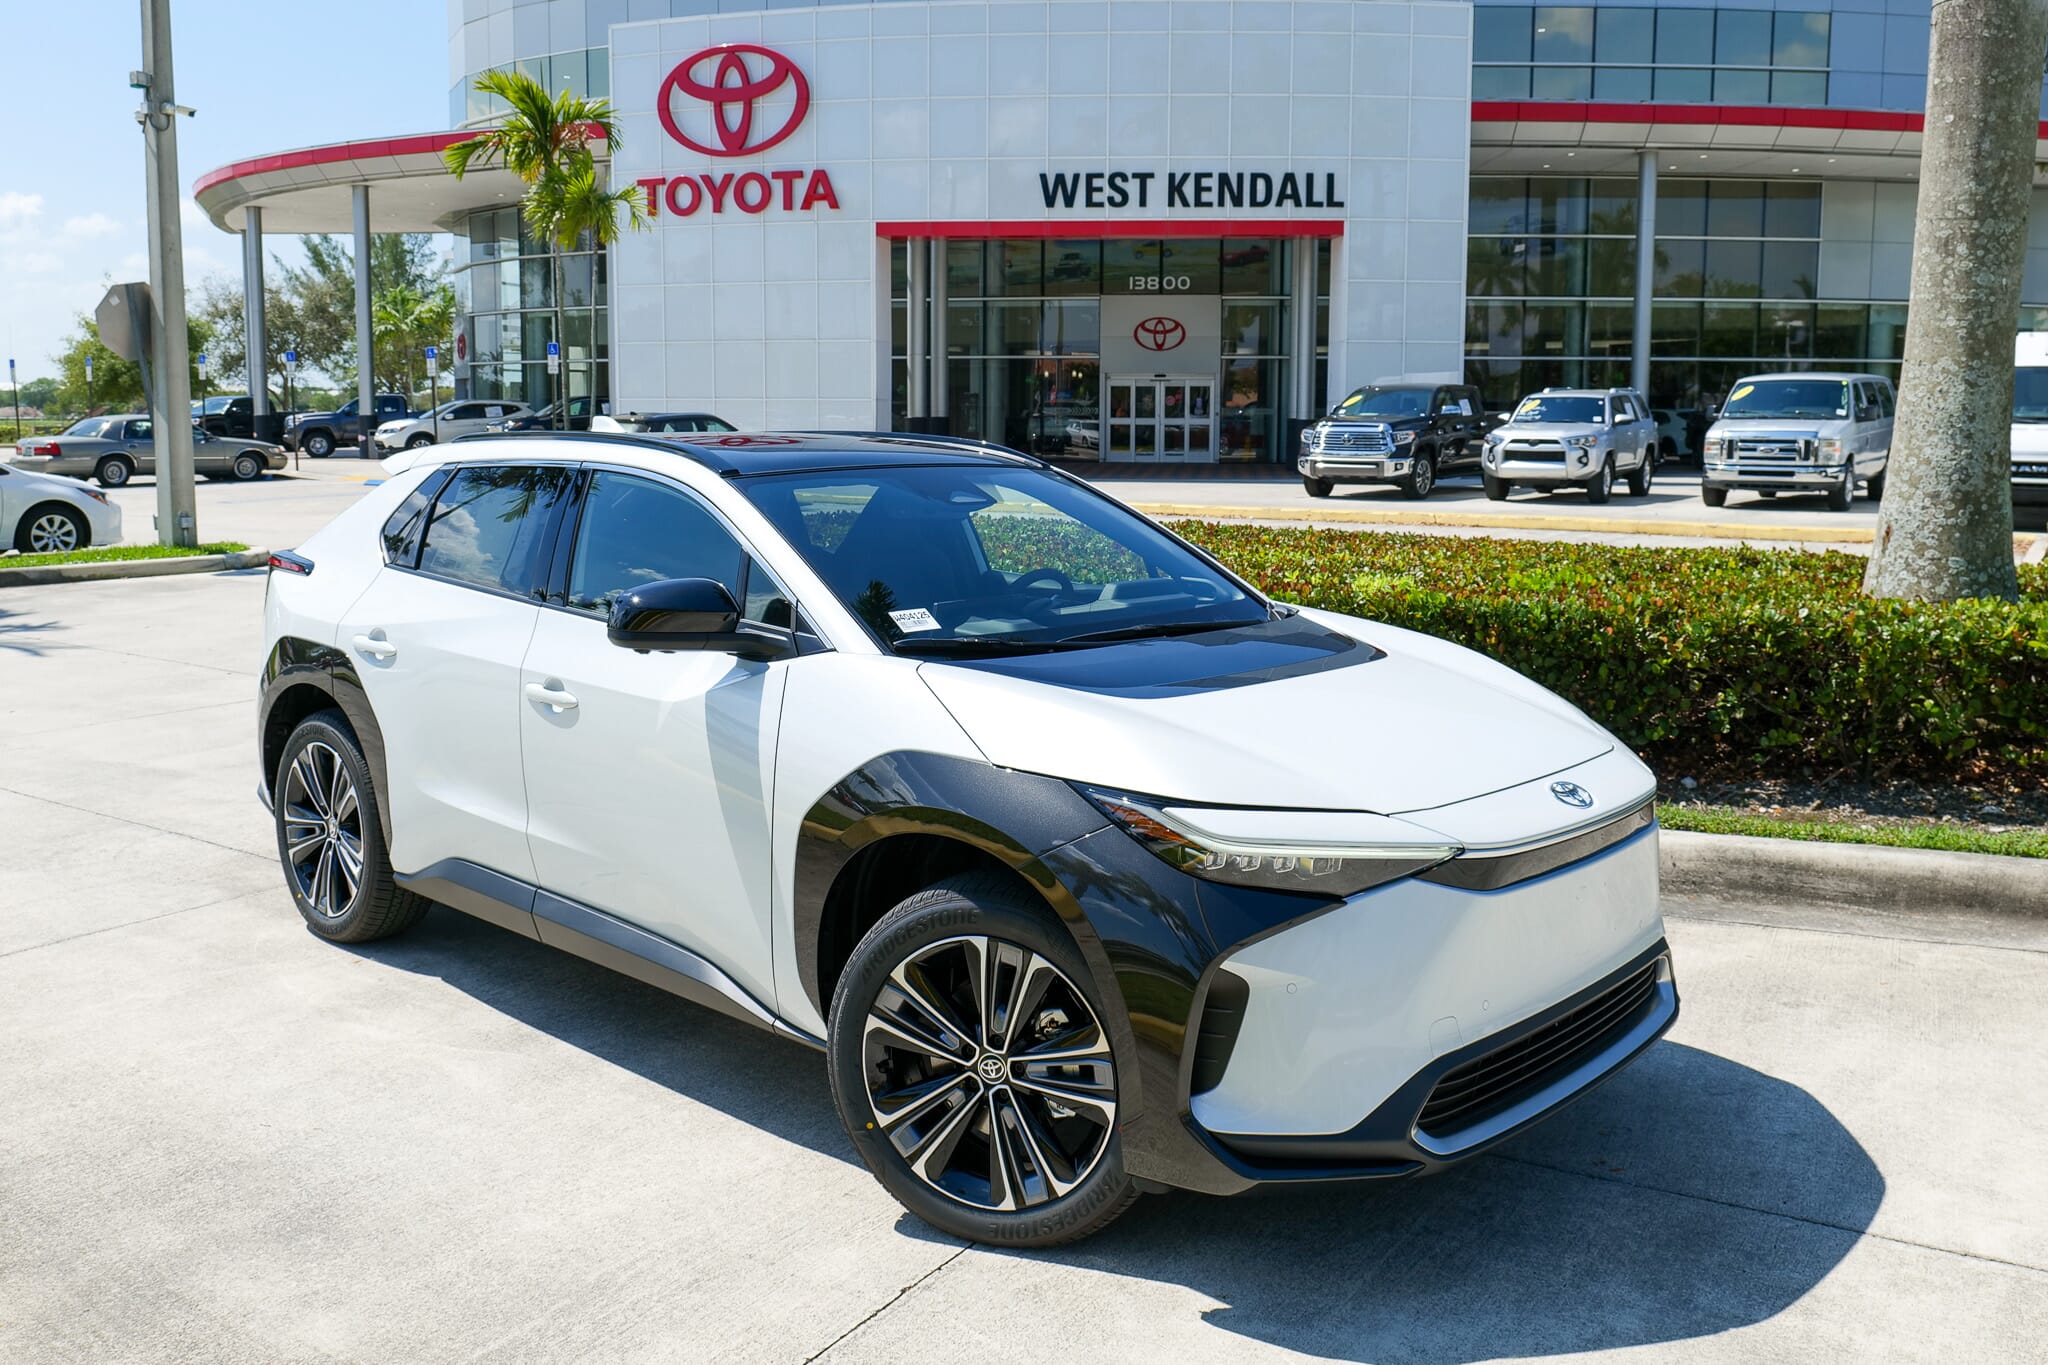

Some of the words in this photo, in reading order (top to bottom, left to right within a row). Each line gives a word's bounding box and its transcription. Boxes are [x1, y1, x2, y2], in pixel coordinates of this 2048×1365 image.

[637, 169, 840, 217] TOYOTA
[1039, 171, 1155, 208] WEST
[1167, 172, 1345, 208] KENDALL
[1129, 276, 1191, 290] 13800
[861, 908, 979, 984] BRIDGESTONE
[986, 1169, 1123, 1241] BRIDGESTONE
